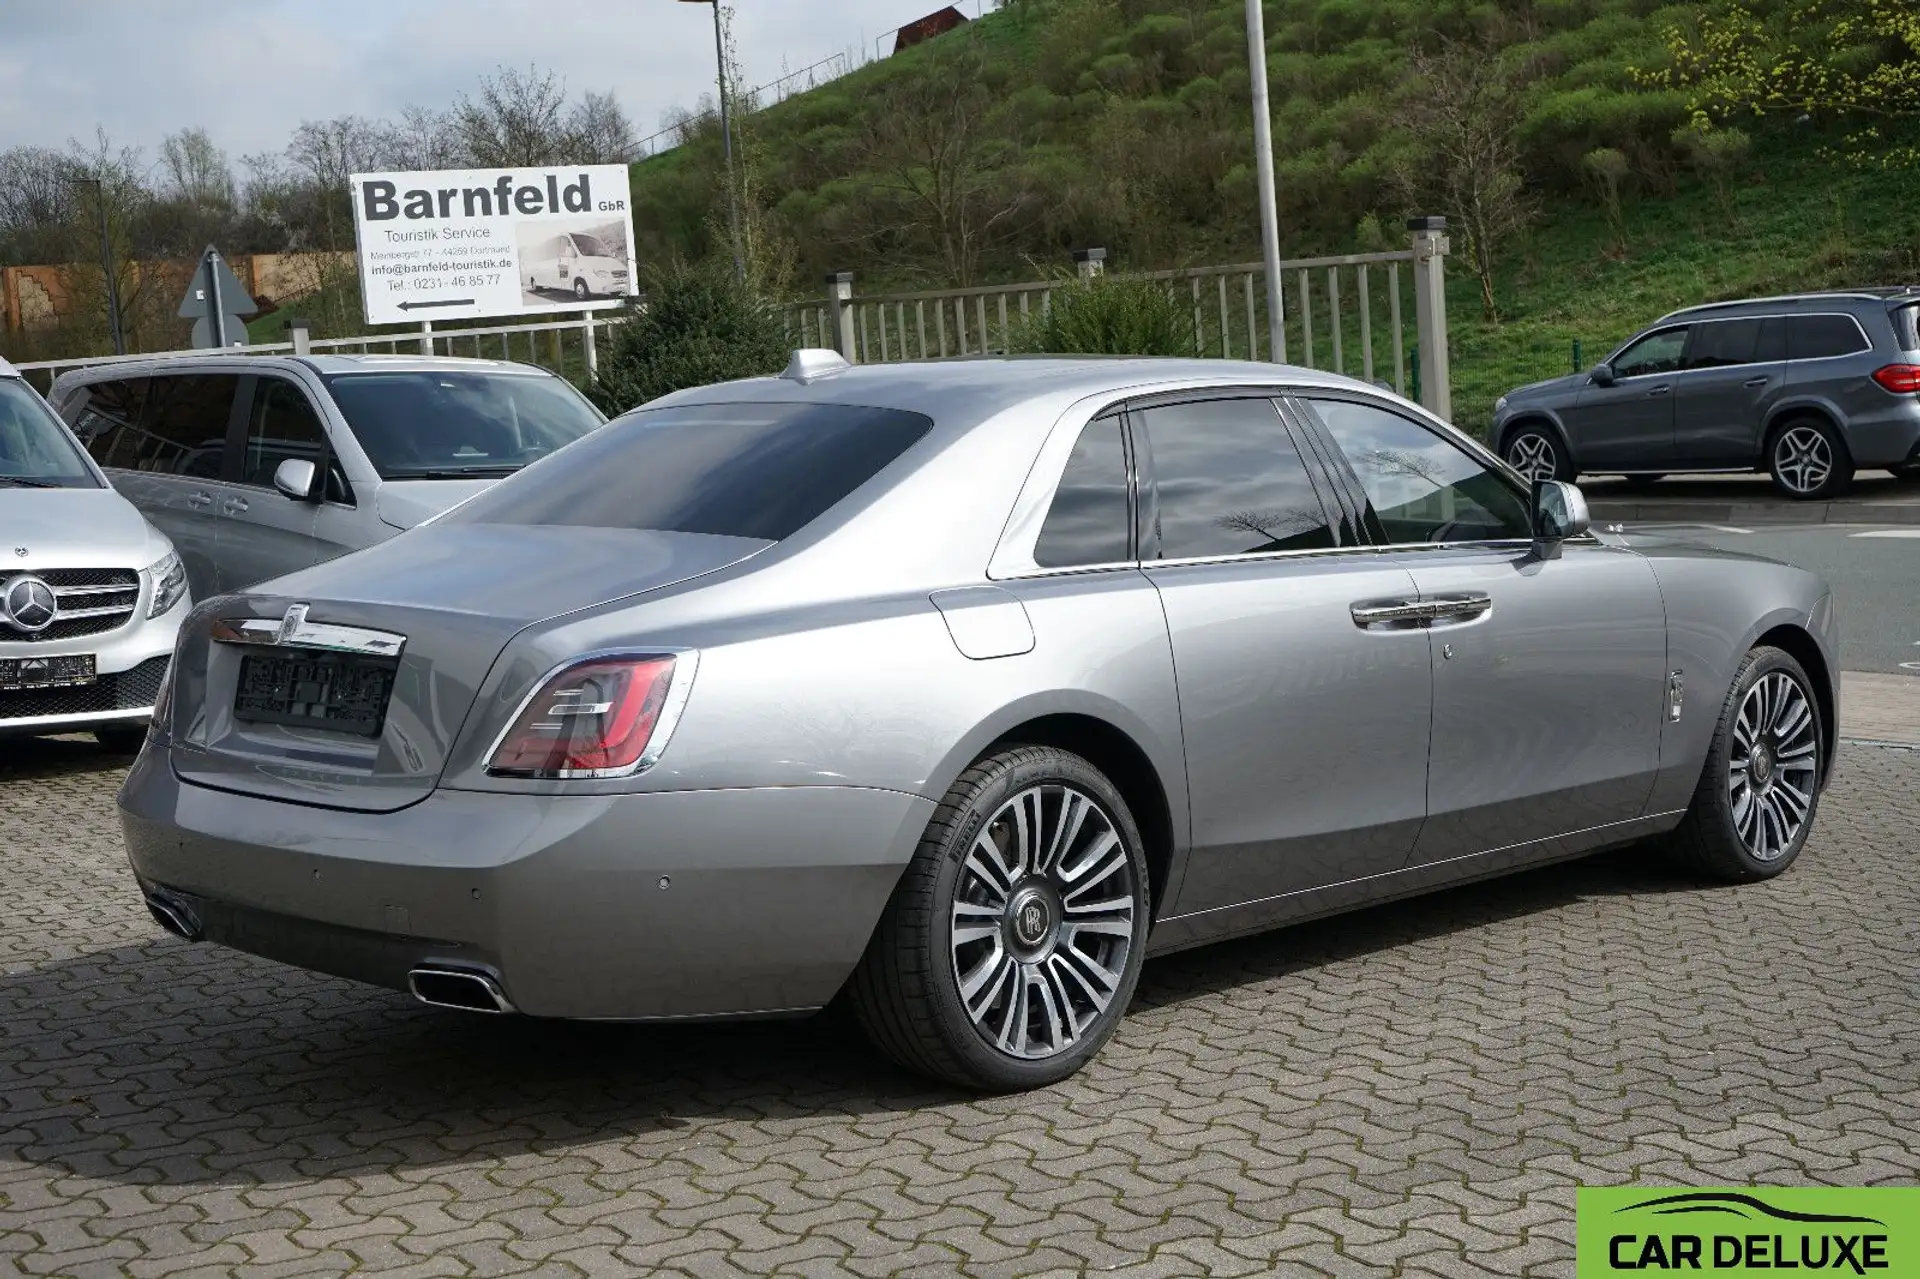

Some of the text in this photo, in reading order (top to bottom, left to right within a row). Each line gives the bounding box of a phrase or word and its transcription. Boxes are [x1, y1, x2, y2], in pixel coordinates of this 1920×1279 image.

[362, 174, 625, 221] Barnfeld GbR
[384, 226, 491, 243] Touristik Service
[371, 258, 513, 276] info@barnfeld-touristik.de
[413, 277, 442, 290] 0231
[469, 275, 484, 287] 85
[486, 273, 501, 285] 77
